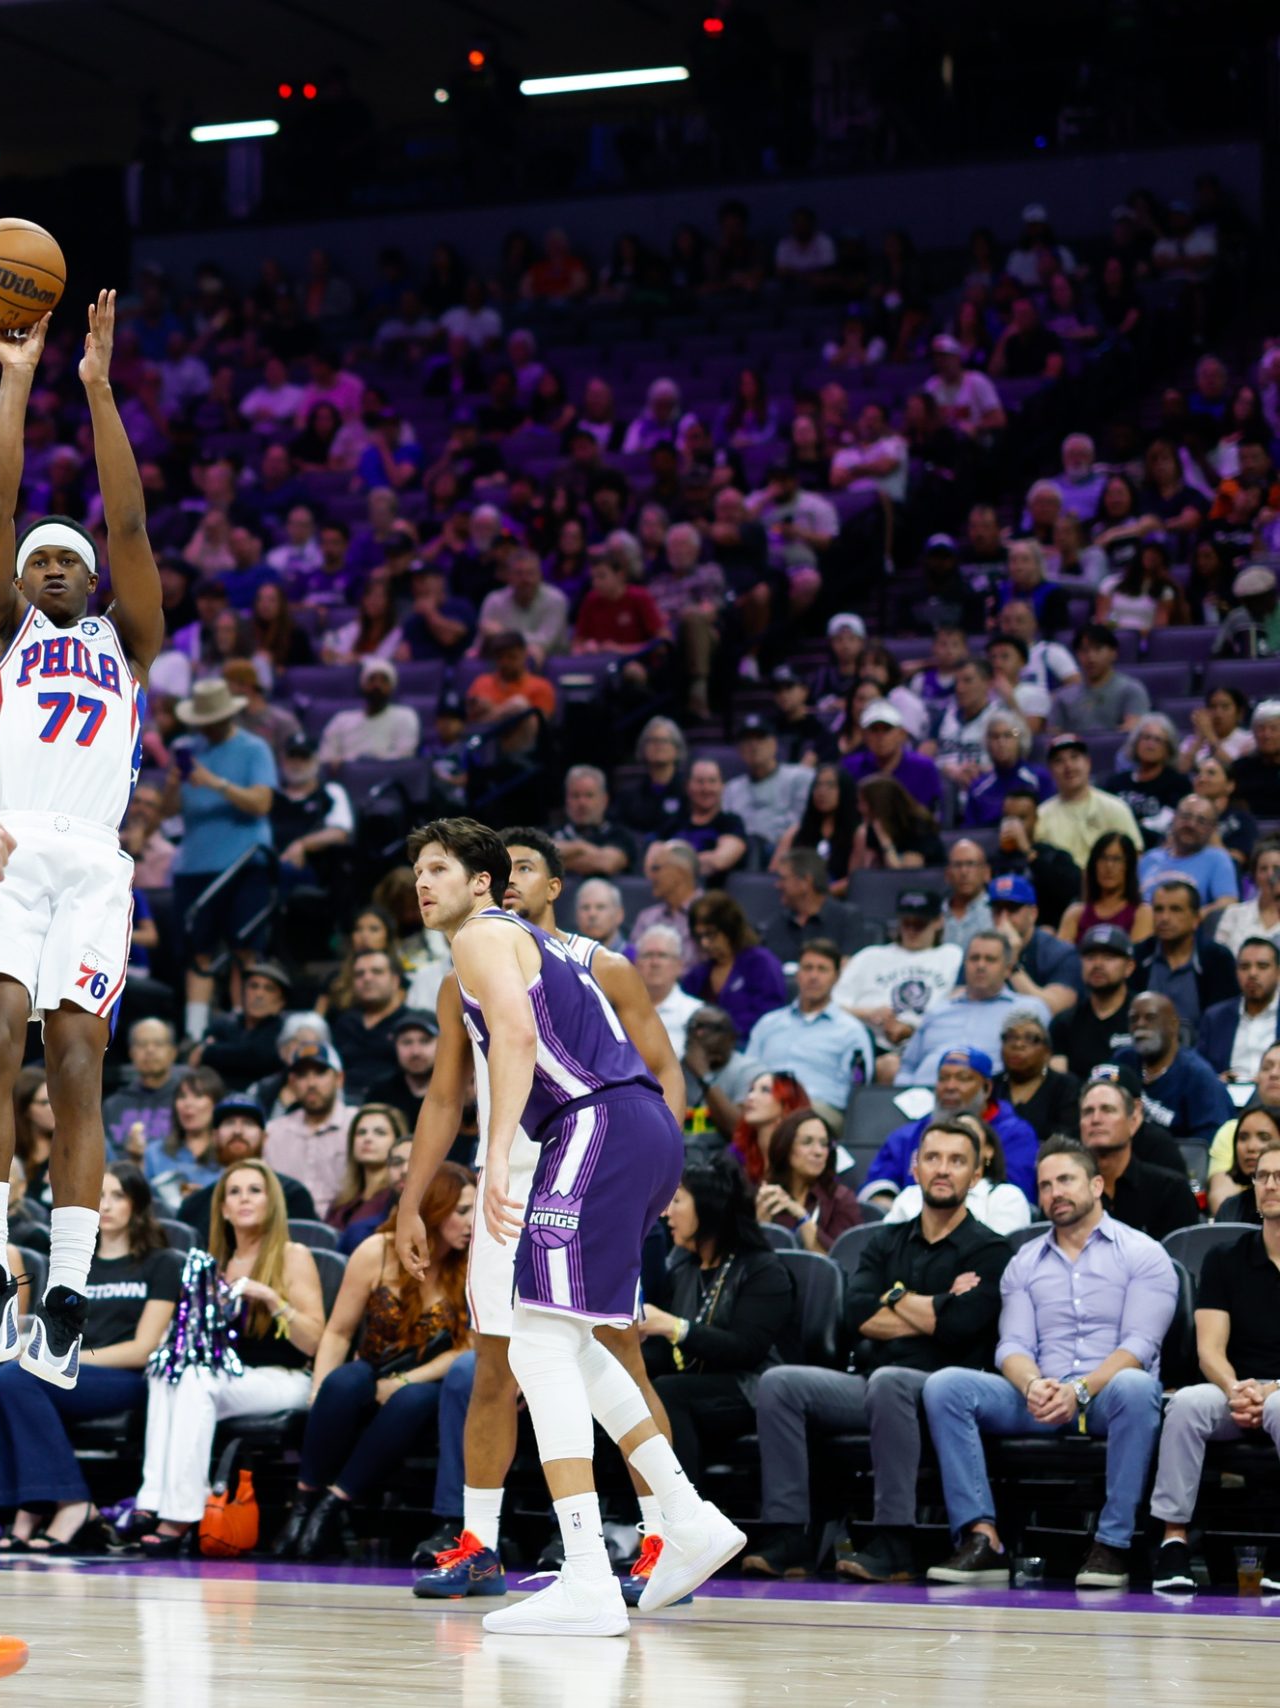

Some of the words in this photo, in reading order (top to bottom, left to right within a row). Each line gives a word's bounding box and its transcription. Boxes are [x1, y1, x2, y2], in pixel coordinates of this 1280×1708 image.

[16, 636, 122, 700] PHILA
[38, 691, 107, 747] 77
[75, 962, 109, 999] 76
[528, 1211, 580, 1230] KINGS
[85, 1282, 148, 1299] CTOWN
